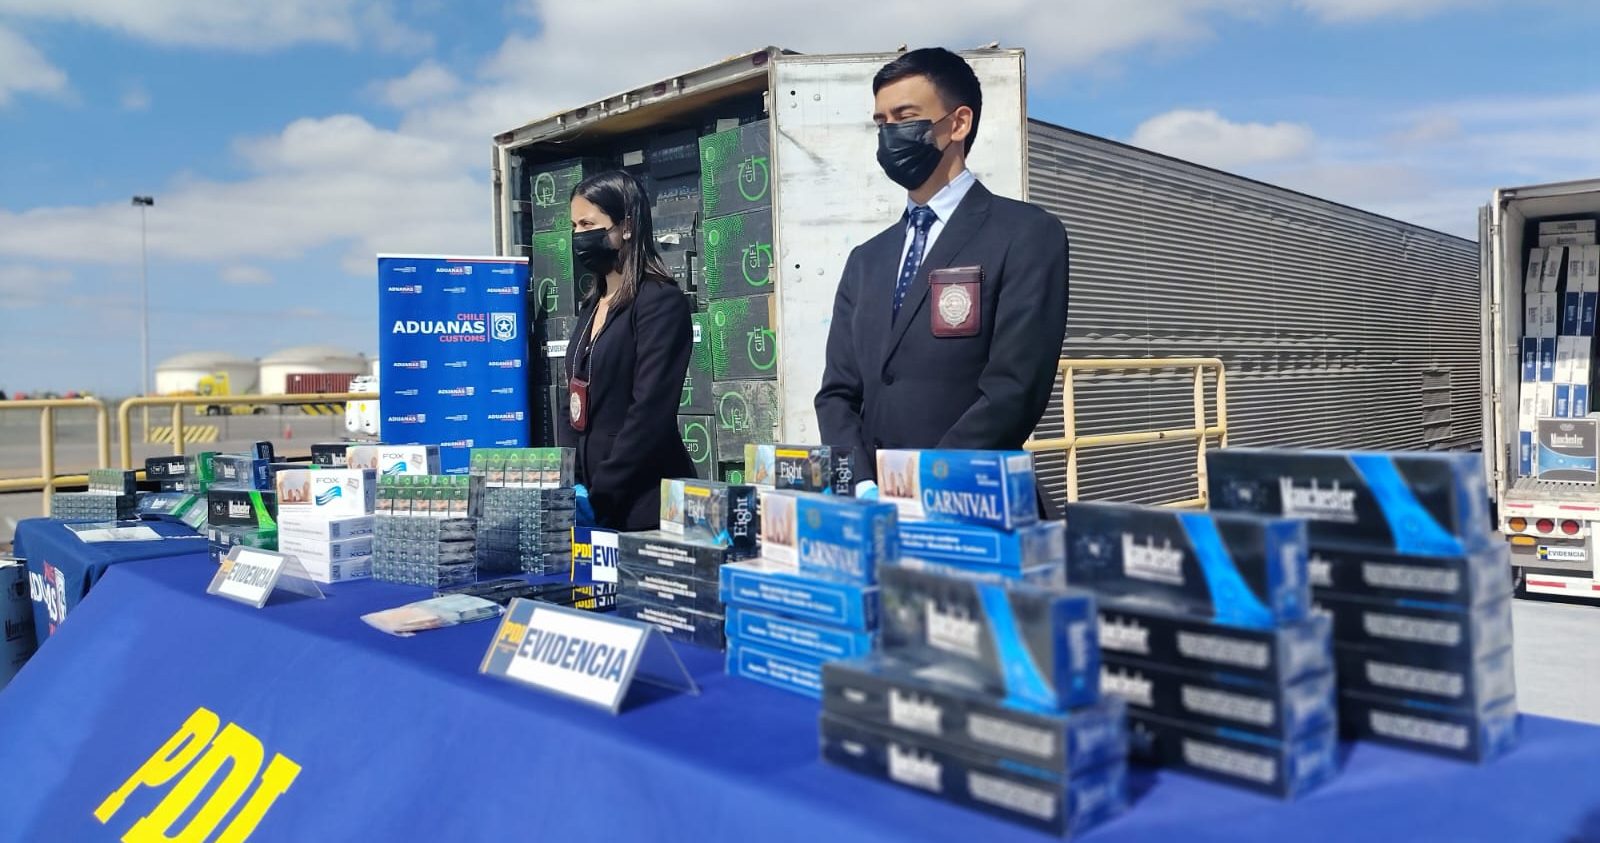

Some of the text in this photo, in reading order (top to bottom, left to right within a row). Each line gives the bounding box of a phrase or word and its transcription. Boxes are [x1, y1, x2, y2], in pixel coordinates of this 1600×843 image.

[744, 157, 753, 183] GIFT
[749, 244, 757, 269] GIFT
[392, 320, 486, 334] ADUANAS
[456, 313, 485, 321] CHILE
[439, 335, 486, 343] CUSTOMS
[754, 326, 763, 352] GIFT
[780, 461, 803, 485] Eight
[835, 457, 854, 494] Eight
[923, 488, 1003, 521] CARNIVAL
[1279, 477, 1357, 514] Manchester
[687, 499, 706, 525] Eight
[733, 497, 753, 537] Eight
[574, 543, 592, 558] PDI
[1549, 550, 1585, 558] EVIDENCIA
[227, 562, 275, 589] EVIDENCIA
[517, 627, 629, 683] EVIDENCIA
[93, 706, 303, 843] PDI
